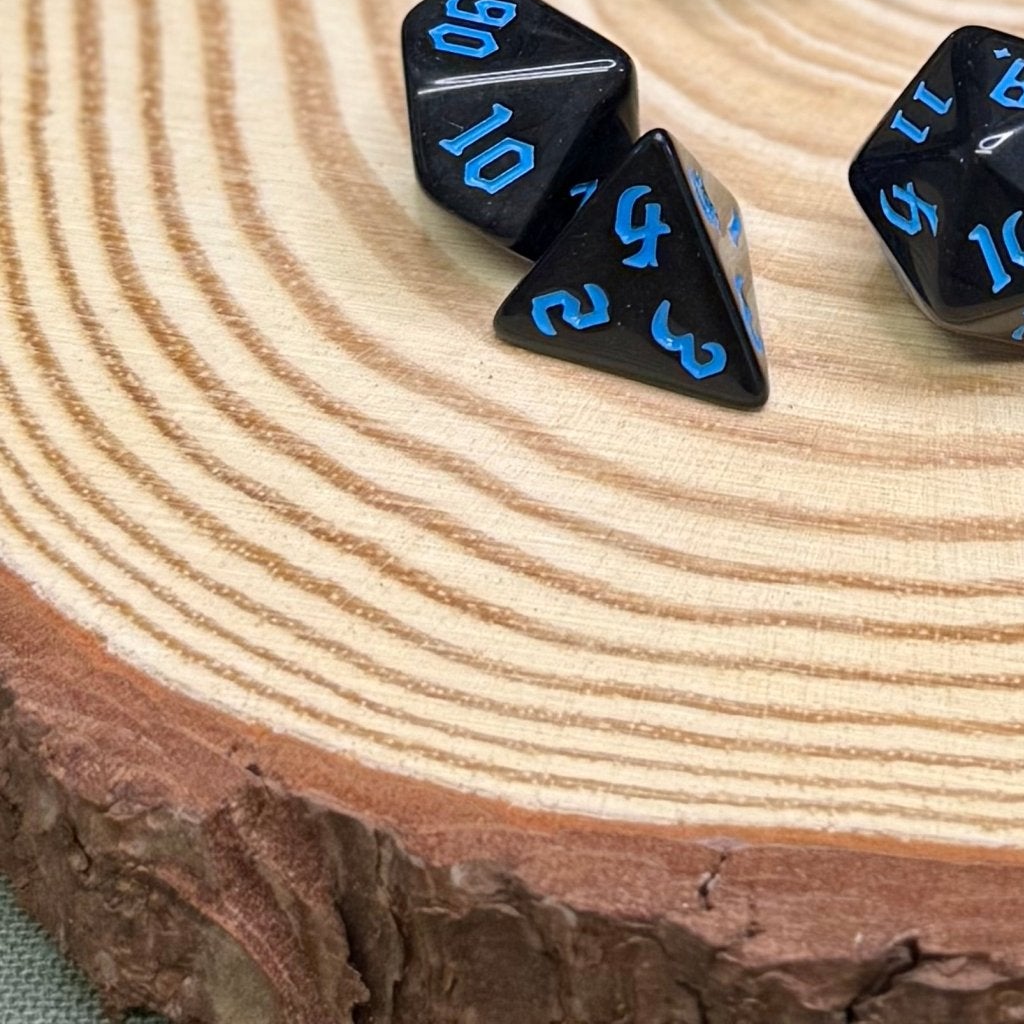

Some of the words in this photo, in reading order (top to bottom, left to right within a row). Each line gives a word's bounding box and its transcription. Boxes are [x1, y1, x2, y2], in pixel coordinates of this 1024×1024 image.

[889, 81, 953, 144] 11
[438, 103, 536, 195] 10
[614, 184, 672, 269] 4
[879, 182, 939, 237] 4
[531, 283, 610, 337] 2
[650, 299, 728, 380] 3
